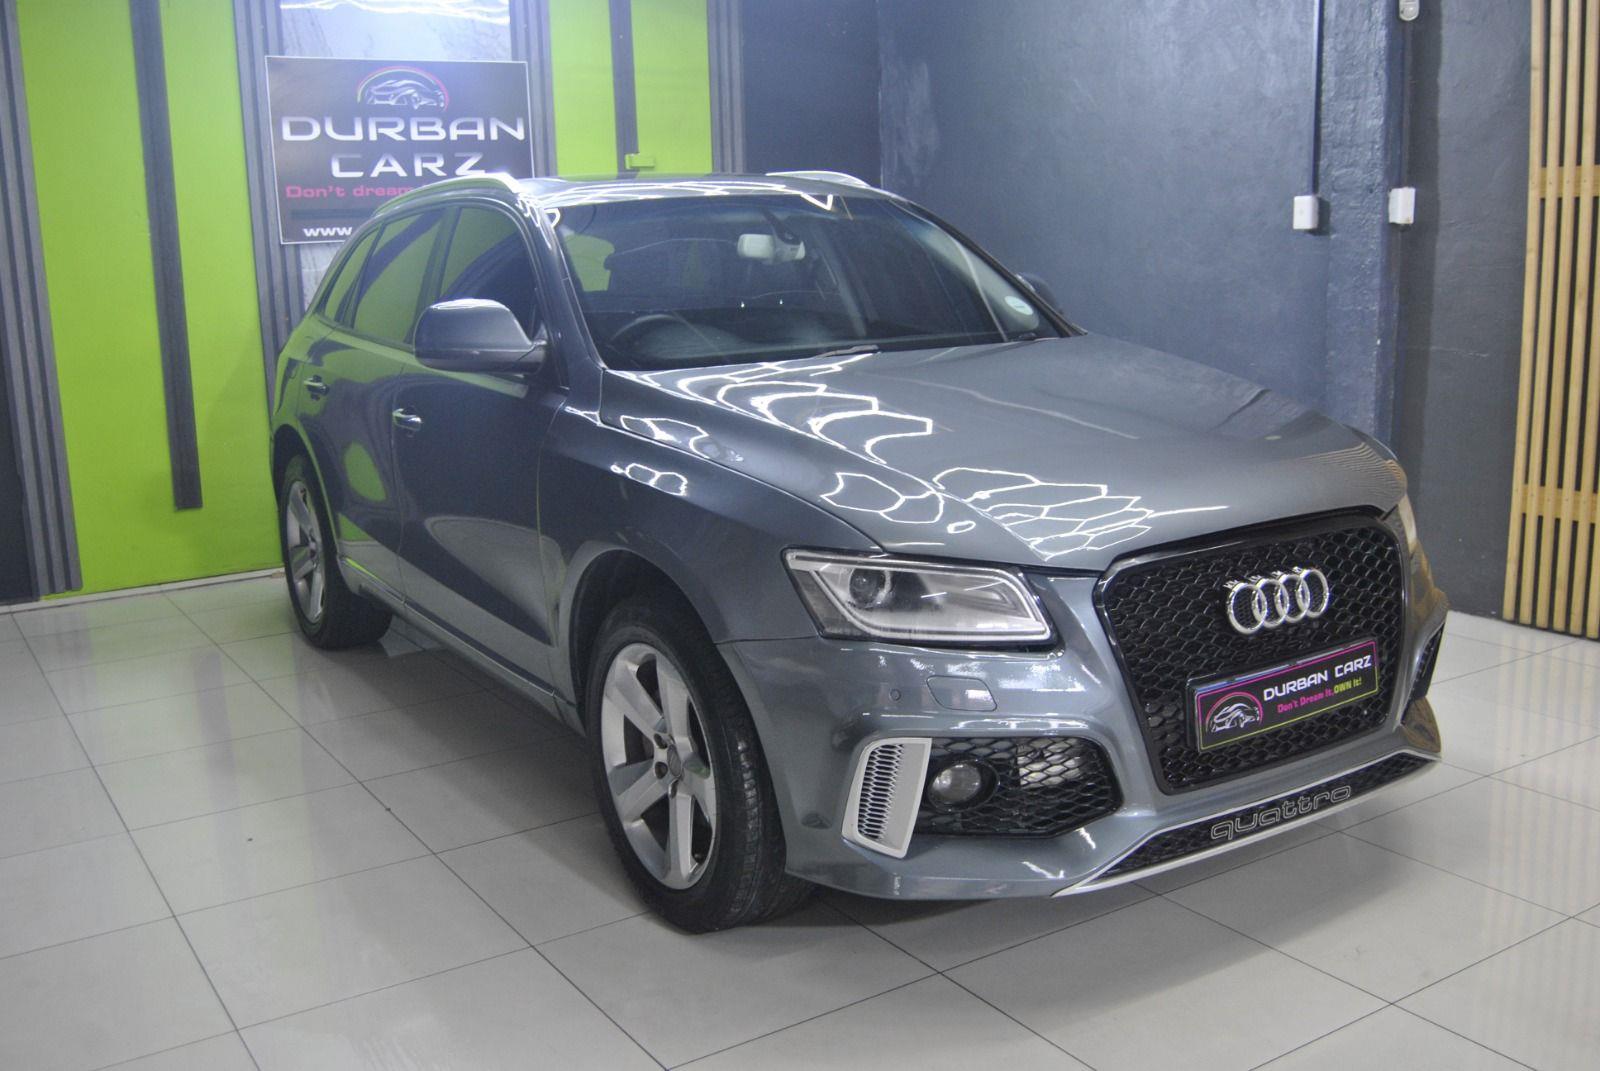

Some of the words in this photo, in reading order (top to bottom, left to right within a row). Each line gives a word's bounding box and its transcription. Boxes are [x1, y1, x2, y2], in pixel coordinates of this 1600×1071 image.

[281, 116, 525, 141] DURBAN
[331, 152, 485, 178] CARZ
[285, 185, 346, 198] Don't
[1263, 670, 1328, 701] DURBAN
[1334, 655, 1372, 678] CARZ
[1277, 700, 1299, 713] Don't
[1300, 692, 1324, 706] Dream
[1210, 785, 1351, 840] quattro
